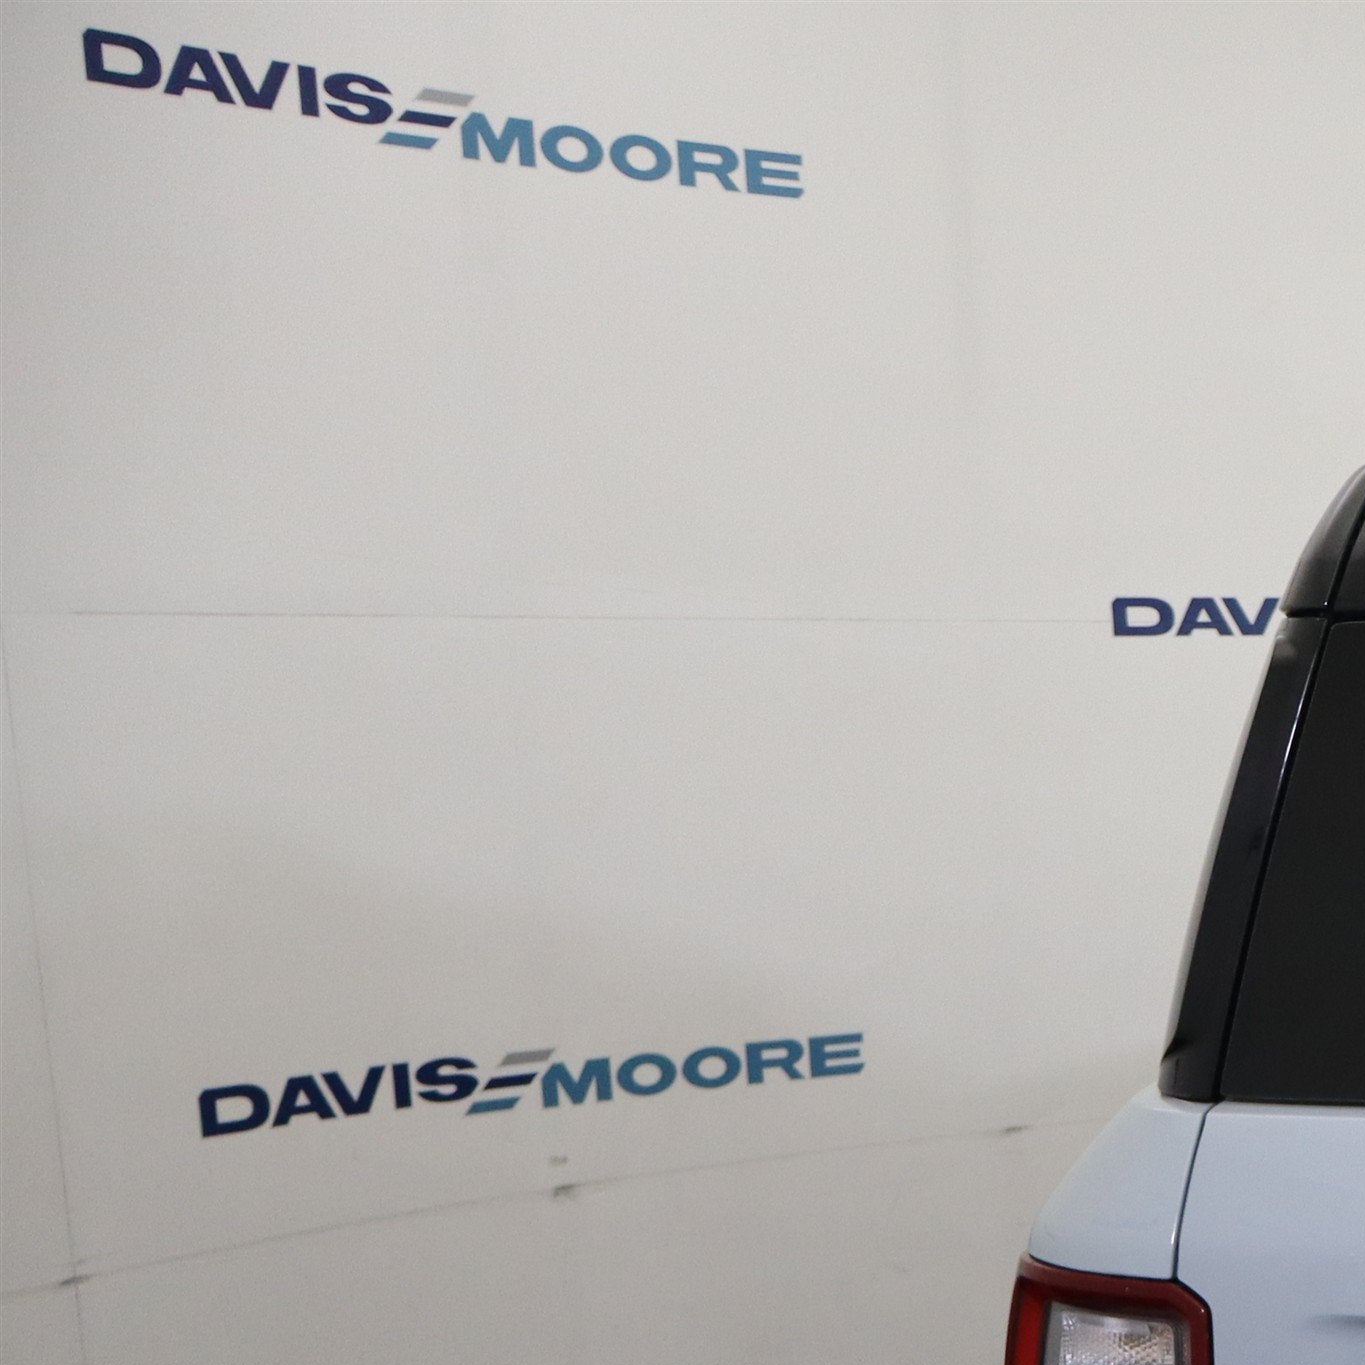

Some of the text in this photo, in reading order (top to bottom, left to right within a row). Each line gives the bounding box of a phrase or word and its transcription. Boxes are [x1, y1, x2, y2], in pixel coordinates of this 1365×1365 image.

[82, 27, 804, 199] DAVIS MOORE
[198, 1033, 864, 1139] DAVIS MOORE
